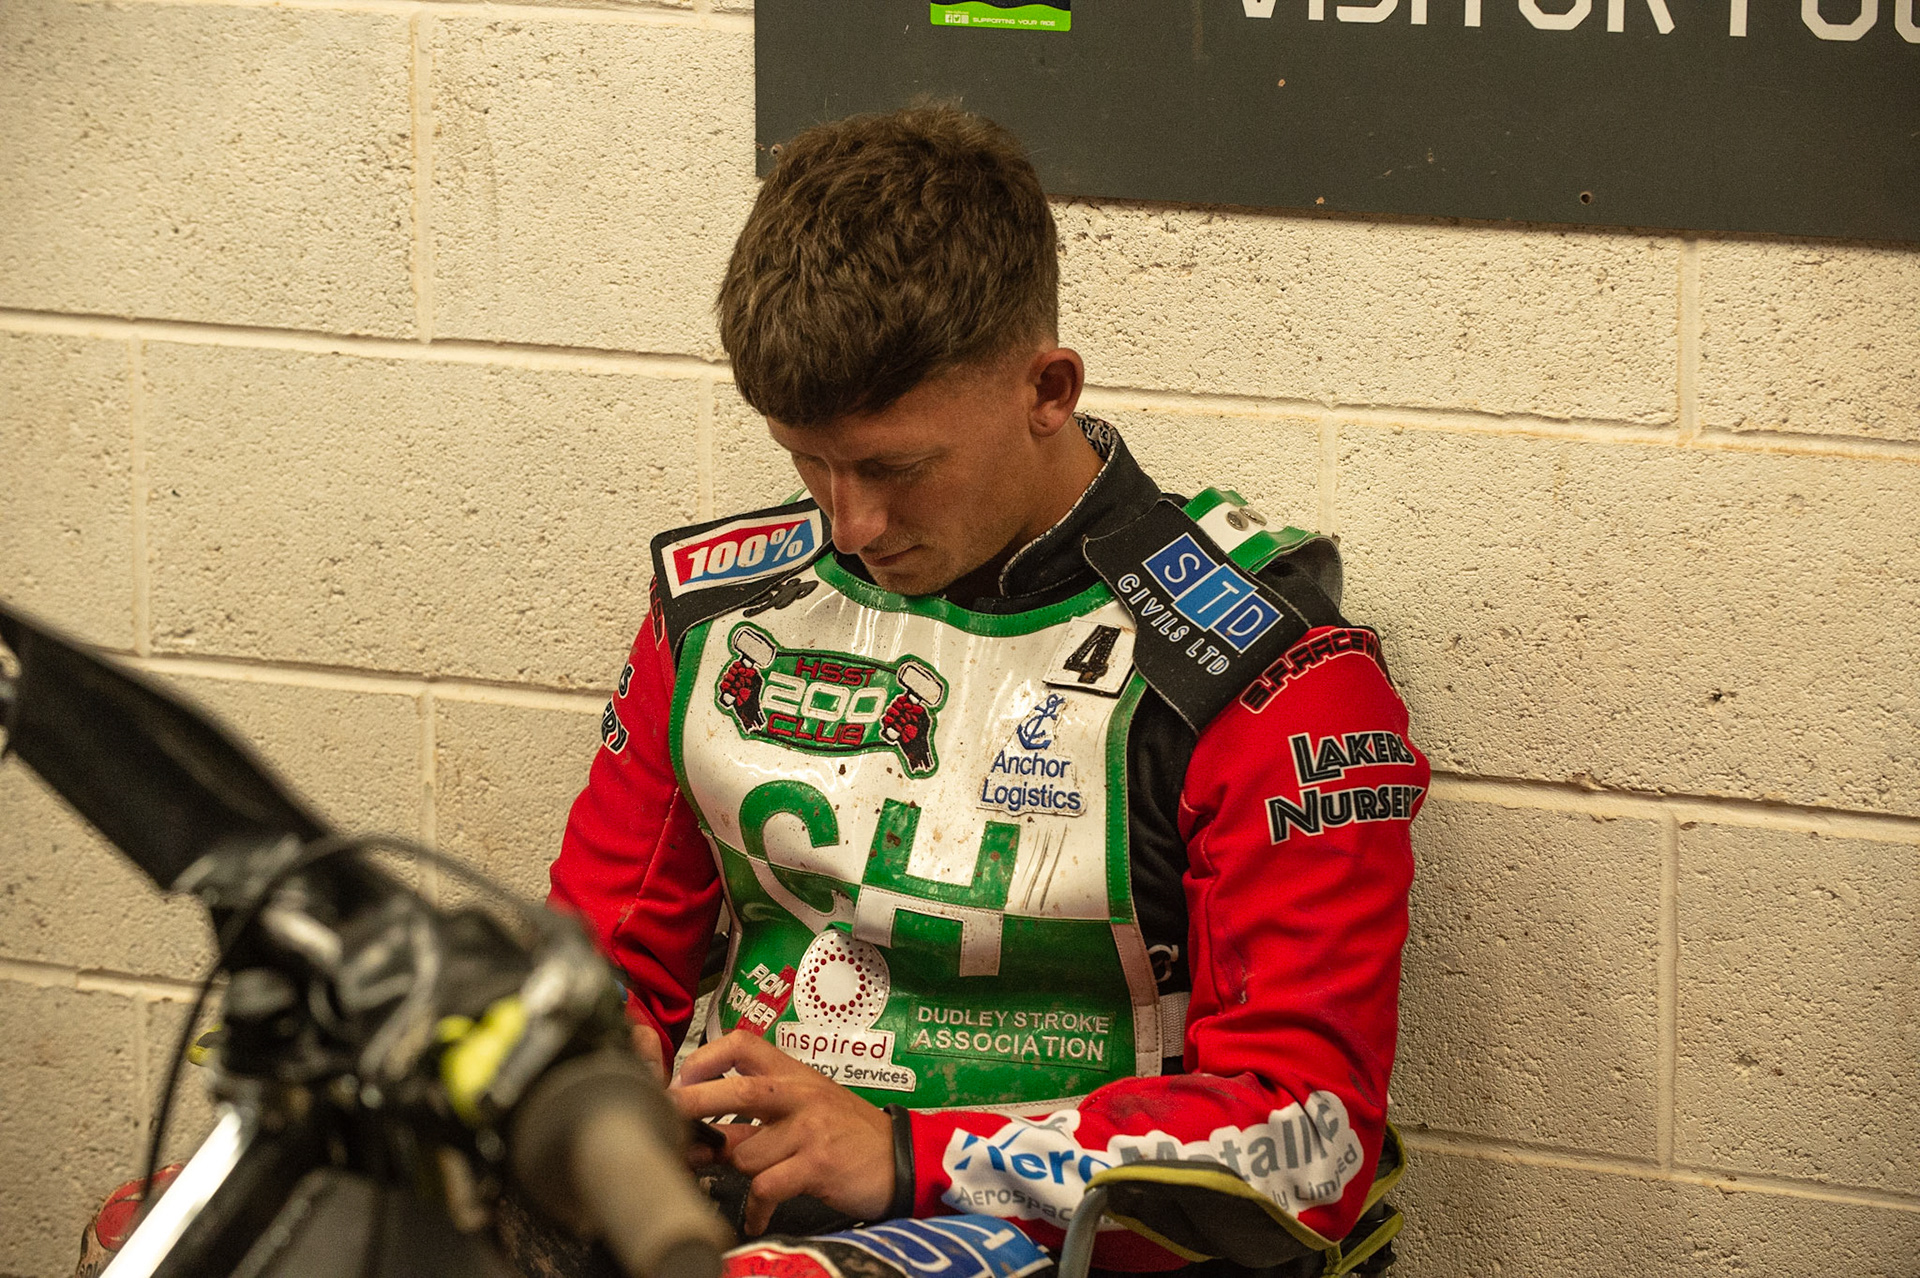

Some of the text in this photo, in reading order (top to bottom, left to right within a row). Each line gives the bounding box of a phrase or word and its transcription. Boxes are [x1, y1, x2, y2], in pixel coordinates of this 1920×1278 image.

[972, 17, 1016, 25] SUPPORTING
[687, 523, 804, 579] 100%
[1160, 549, 1268, 640] STD
[1117, 573, 1230, 676] CIVILS LTD
[1062, 623, 1122, 685] 4
[794, 656, 876, 688] HSST
[761, 670, 889, 723] 200
[766, 711, 866, 746] CLUB
[990, 750, 1071, 779] Anchor
[980, 778, 1082, 812] Logistics
[917, 1005, 1111, 1034] DUDLEY STROKE
[781, 1027, 888, 1060] inspired
[910, 1028, 1105, 1062] ASSOCIATION
[843, 1064, 910, 1084] Services
